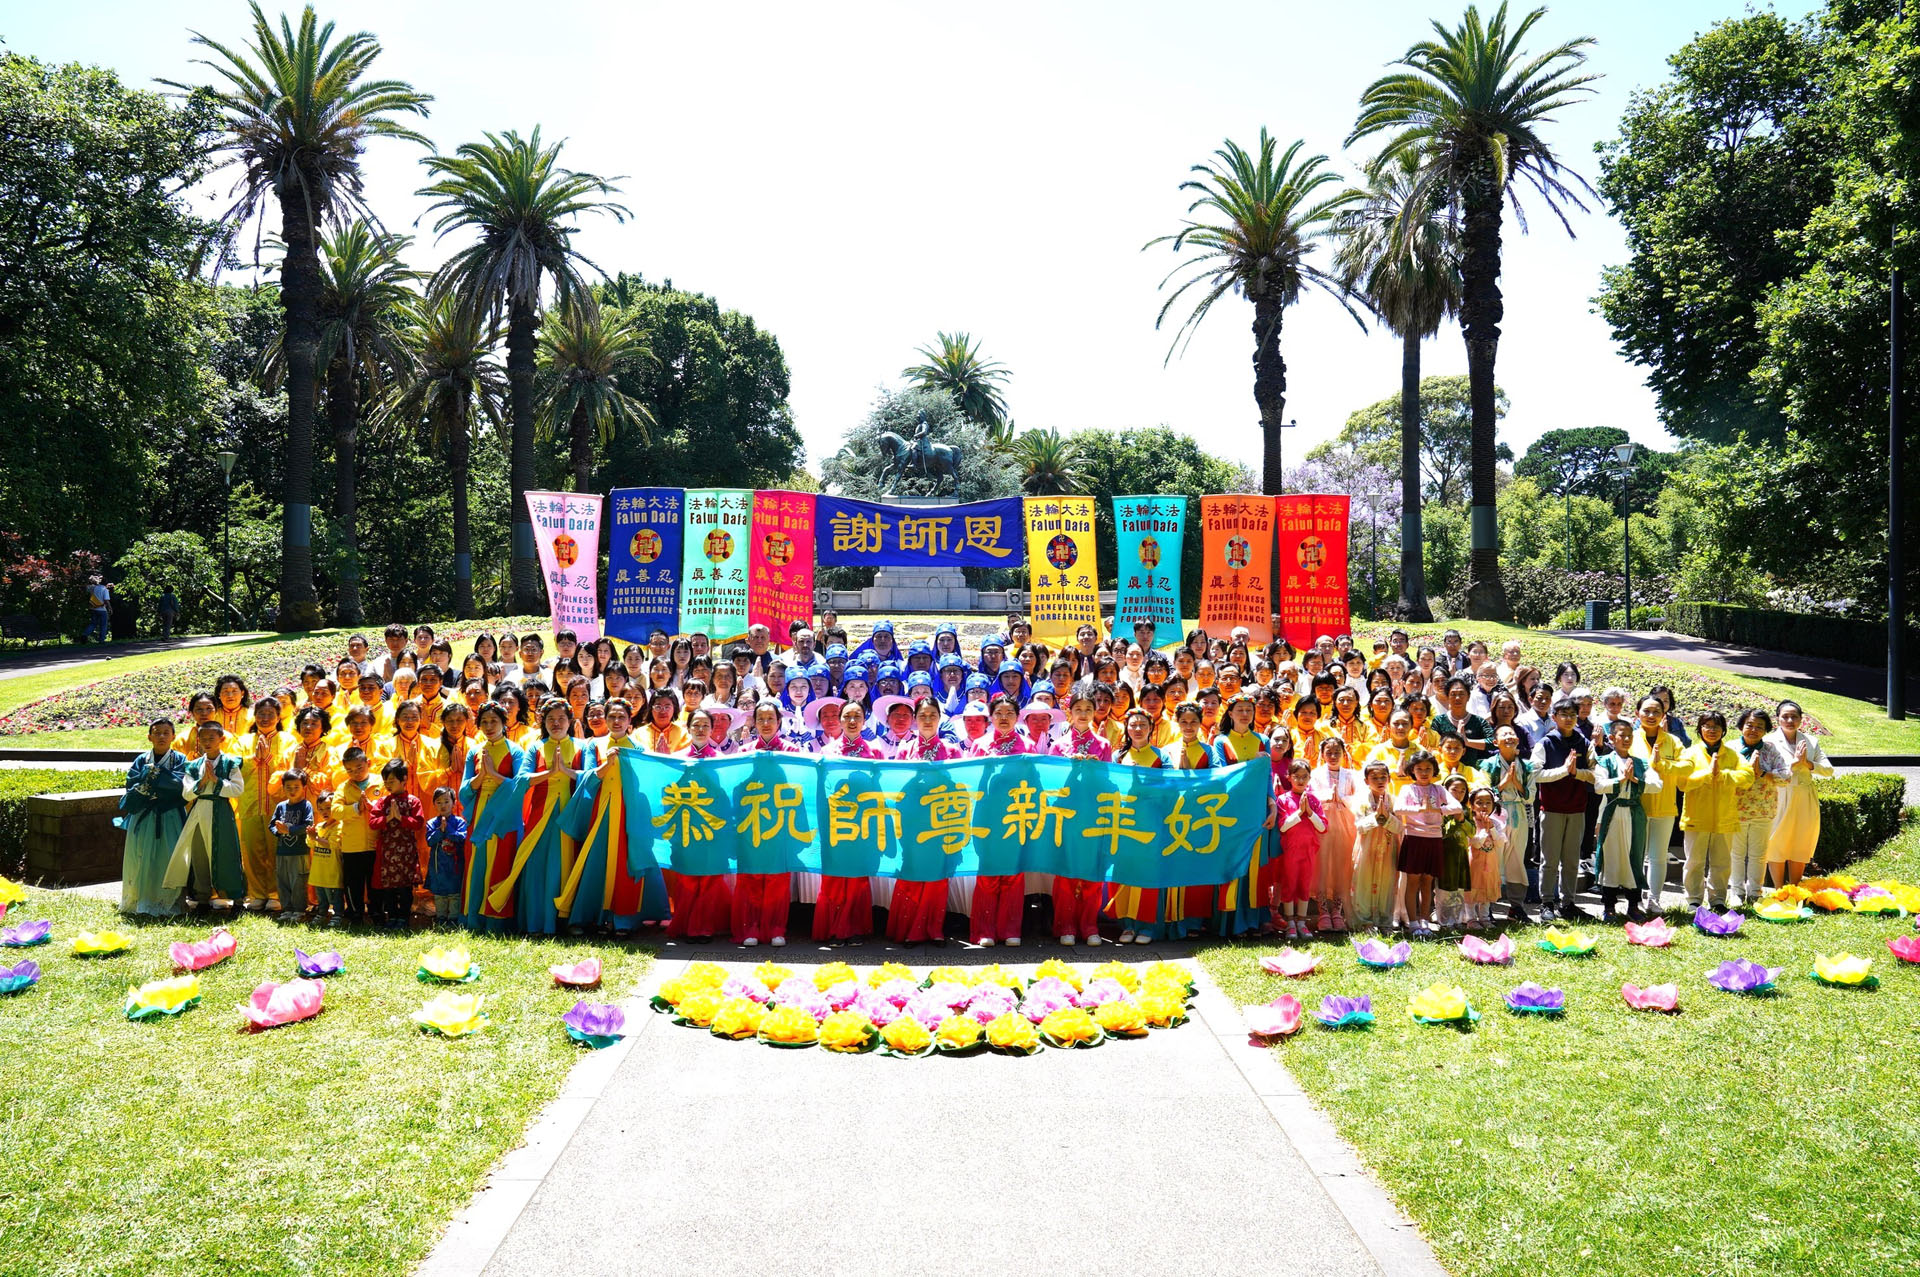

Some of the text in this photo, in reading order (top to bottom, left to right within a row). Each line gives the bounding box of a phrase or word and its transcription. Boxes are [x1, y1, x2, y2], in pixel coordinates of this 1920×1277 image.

[533, 500, 595, 515] 法輪大法
[616, 496, 679, 510] 法輪大法
[689, 497, 748, 510] 法輪大法
[1280, 502, 1344, 516] 法輪大法
[1029, 504, 1090, 517] 法輪大法
[1119, 504, 1180, 518] 法輪大法
[1207, 503, 1269, 517] 法輪大法
[617, 510, 678, 525] Falun Dafa
[690, 512, 747, 525] Falun Dafa
[754, 512, 809, 530] alun Dafa
[569, 518, 595, 530] Dafa
[1031, 519, 1090, 532] Falun Dafa
[1122, 519, 1178, 532] Falun Dafa
[1208, 517, 1268, 531] Falun Dafa
[1282, 518, 1341, 532] Falun Dafa
[829, 511, 1013, 558] 謝師恩
[614, 587, 675, 596] TRUTHFULNESS
[688, 588, 746, 596] TRUTHFULNESS
[613, 596, 674, 605] BENEVOLENCE
[687, 597, 745, 606] BENEVOLENCE
[1035, 594, 1095, 602] TRUTHFULNESS
[1208, 593, 1265, 604] TRUTHFULNESS
[1284, 595, 1343, 605] TRUTHFULNESS
[612, 606, 673, 615] FORBEARANCE
[687, 607, 745, 616] FORBEARANCE
[1035, 604, 1095, 612] BENEVOLENCE
[1207, 603, 1265, 614] BENEVOLENCE
[1284, 606, 1344, 615] BENEVOLENCE
[1035, 613, 1096, 622] FORBEARANCE
[1207, 613, 1265, 624] FORBEARANCE
[1284, 616, 1345, 625] FORBEARANCE
[651, 779, 1238, 857] 恭祝師尊新年好
